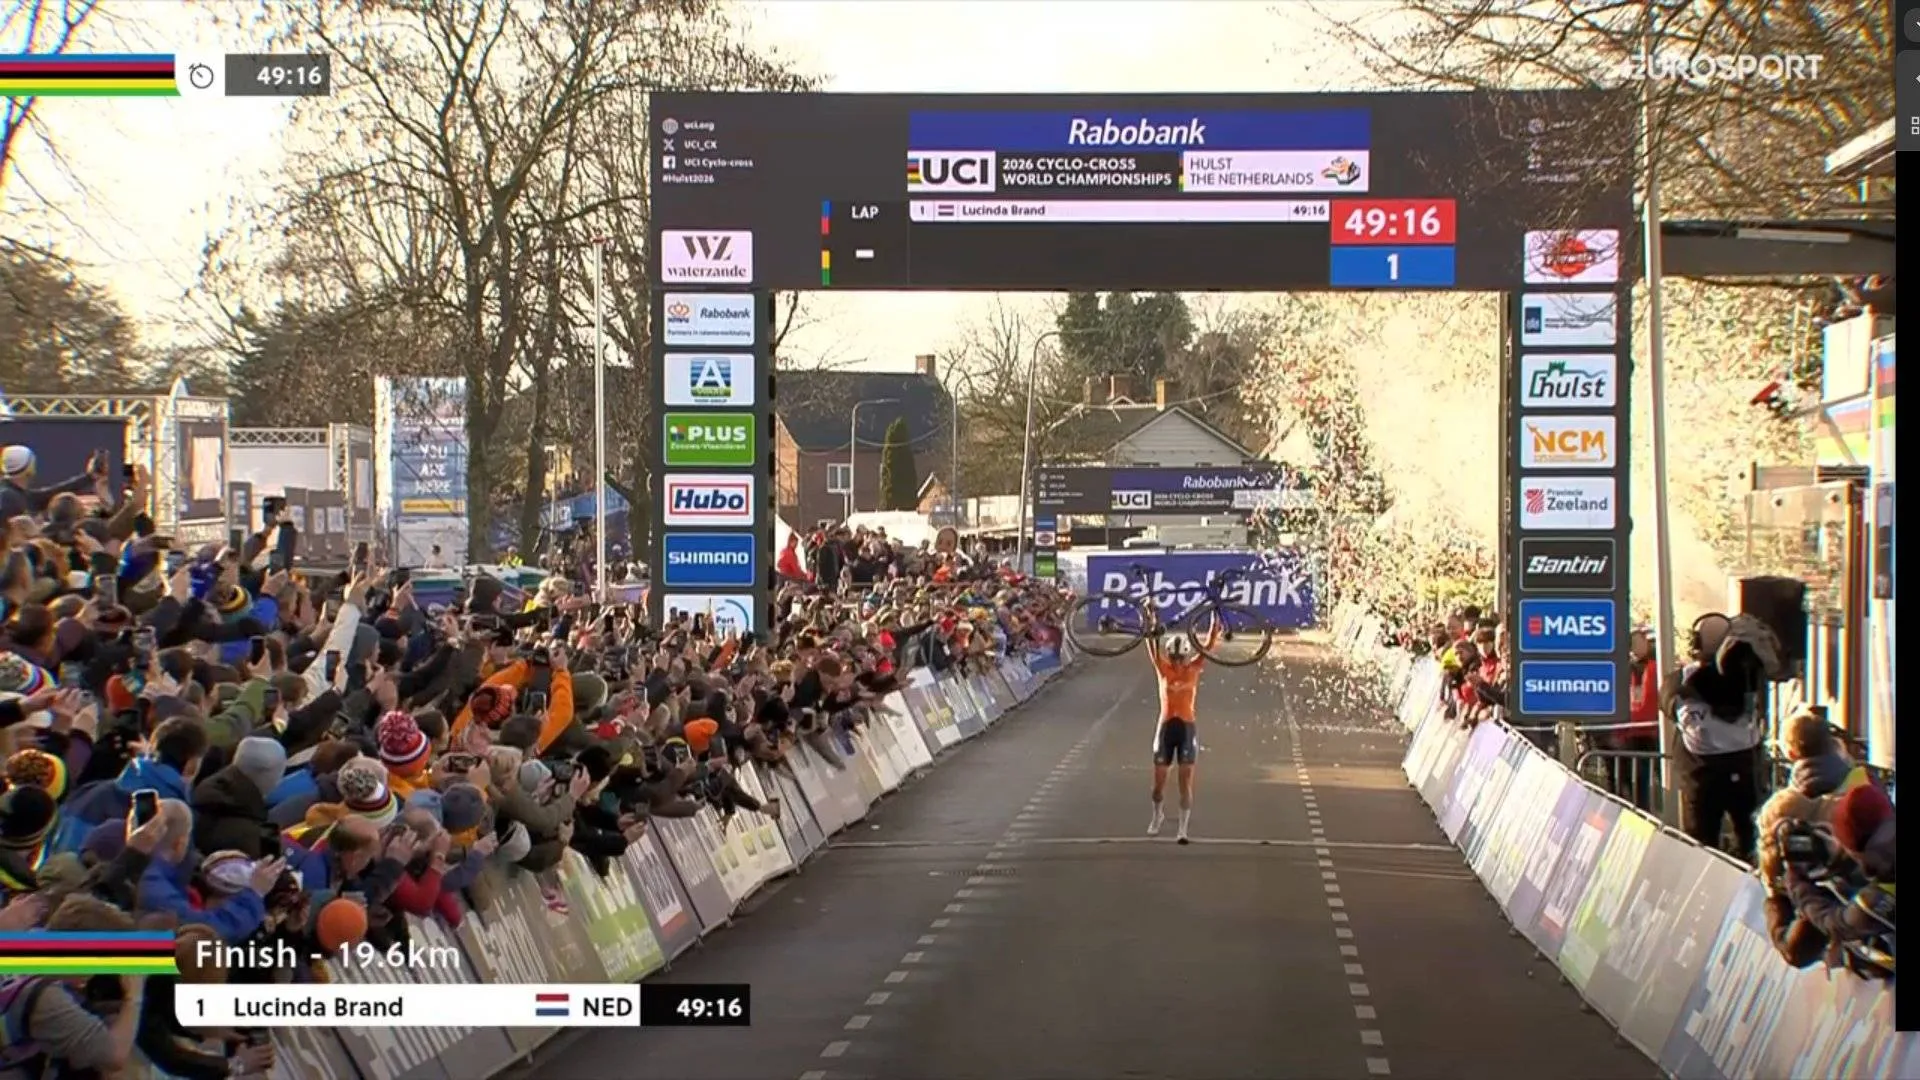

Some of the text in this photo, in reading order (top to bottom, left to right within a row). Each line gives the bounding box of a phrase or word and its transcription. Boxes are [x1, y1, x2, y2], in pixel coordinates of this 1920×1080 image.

[1068, 117, 1206, 146] Rabobank
[683, 158, 701, 168] UCI
[1002, 158, 1136, 171] 2026 CYCLO-CROSS
[1190, 157, 1232, 170] HULST
[922, 158, 989, 185] UCI
[1002, 173, 1172, 187] WORLD CHAMPIONSHIPS
[1190, 172, 1314, 187] THE NETHERLANDS
[851, 206, 879, 219] LAP
[962, 204, 1008, 217] Lucinda
[1011, 204, 1046, 217] Brand
[1293, 205, 1326, 216] 49:16
[1345, 208, 1441, 236] 49:16
[667, 265, 747, 279] waterzande
[1386, 253, 1399, 281] 1
[700, 306, 750, 318] Rabobank
[1538, 376, 1606, 399] hulst
[687, 425, 747, 442] PLUS
[1534, 430, 1604, 453] NCM
[1183, 475, 1243, 489] Rabobank
[674, 488, 745, 510] Hubo
[1120, 494, 1149, 506] UCI
[1547, 497, 1608, 511] Zeeland
[668, 552, 749, 565] SHIMANO
[1527, 555, 1608, 574] Santini
[1544, 616, 1607, 636] MAES
[1525, 679, 1610, 693] SHIMANO
